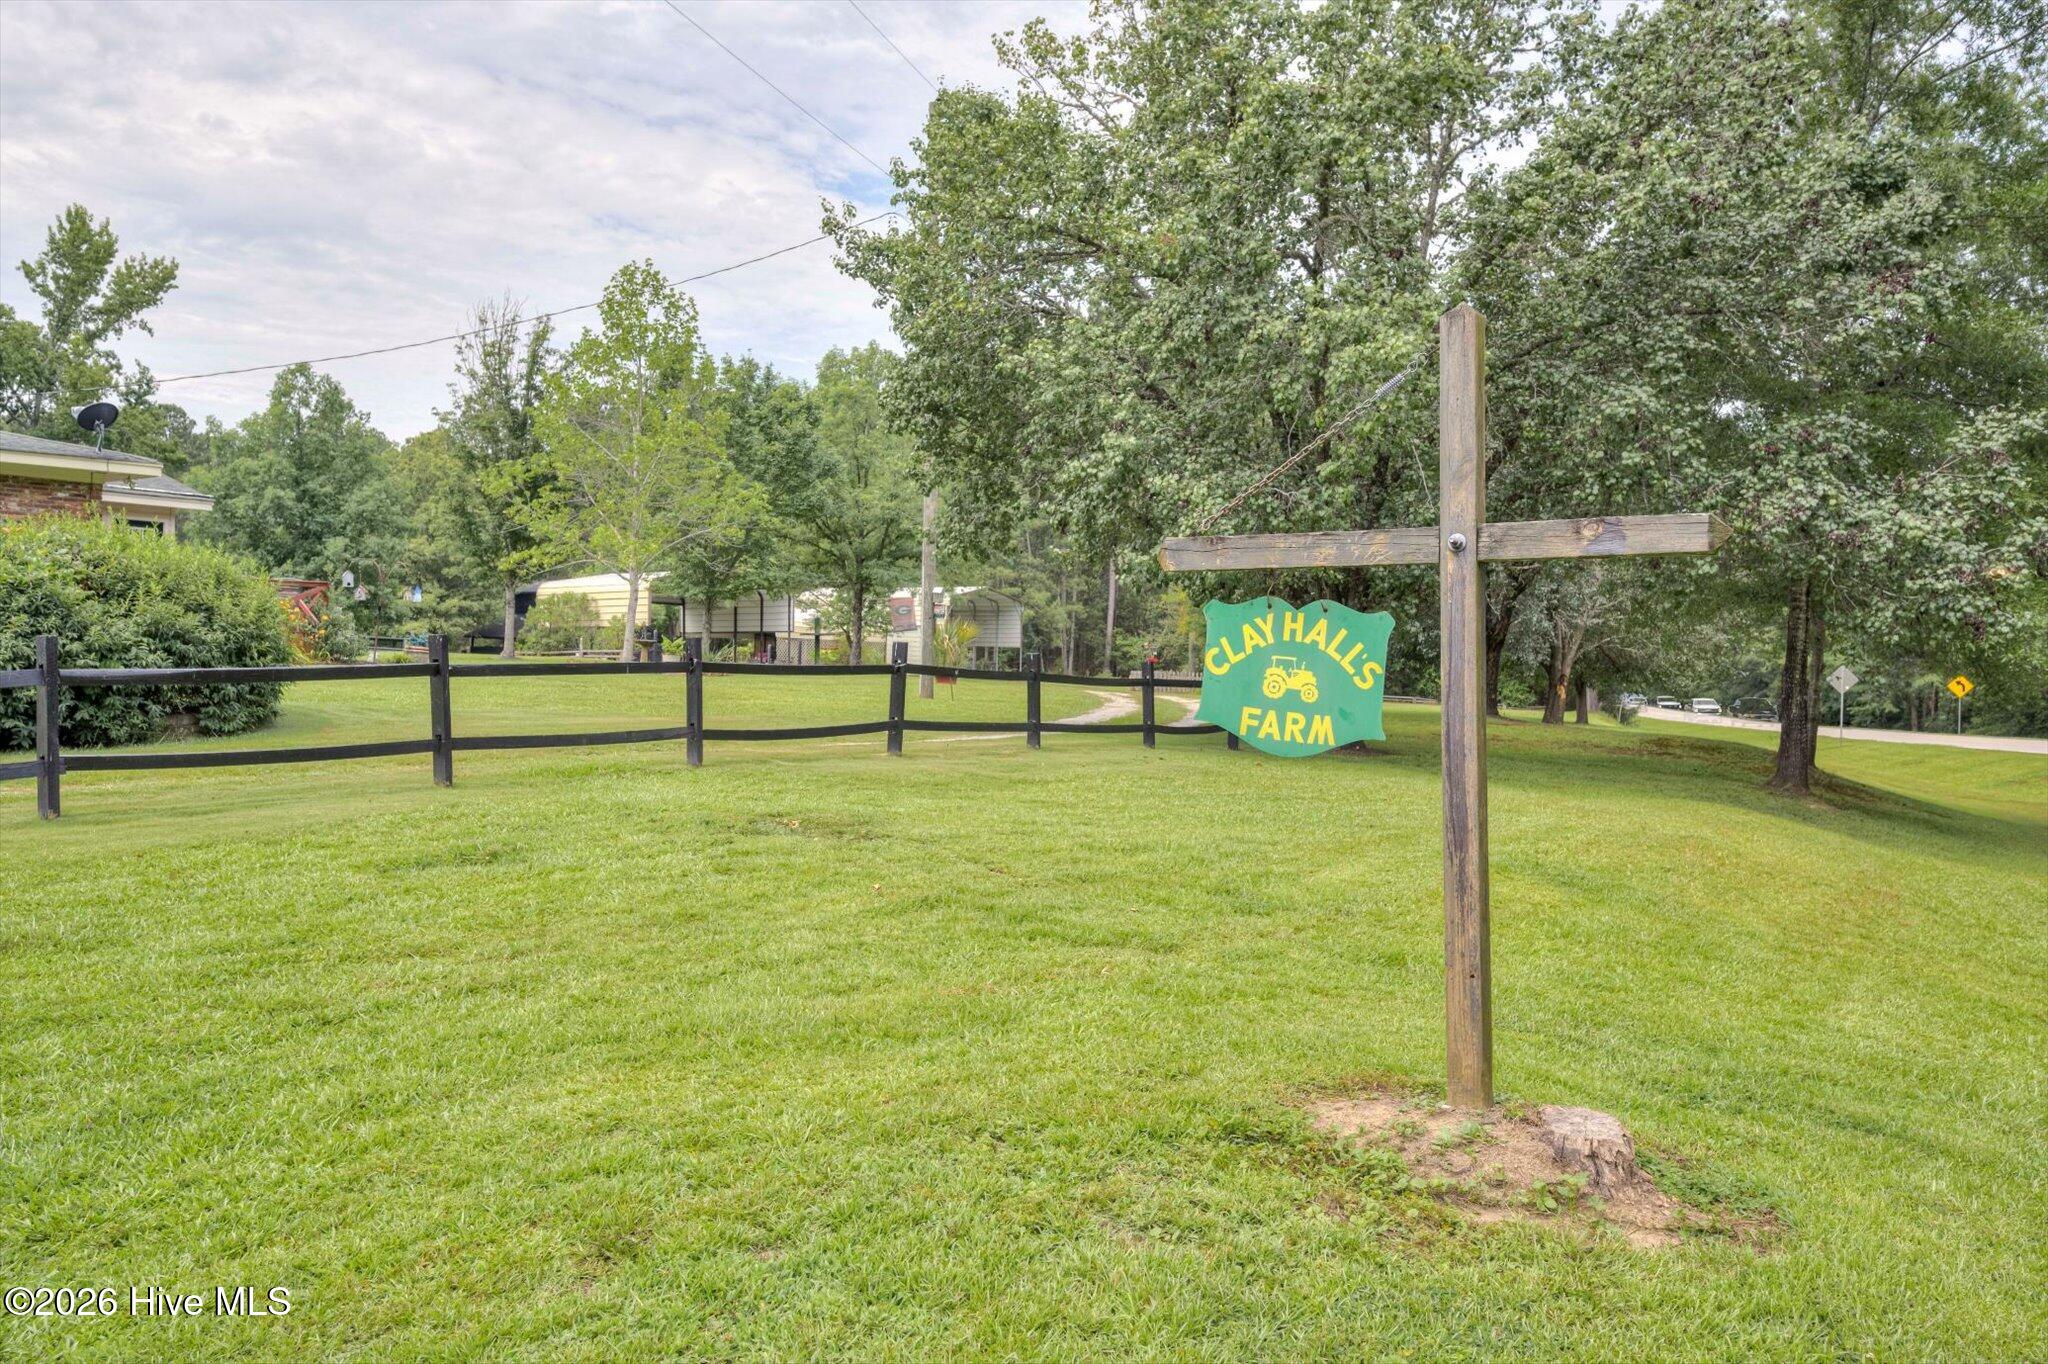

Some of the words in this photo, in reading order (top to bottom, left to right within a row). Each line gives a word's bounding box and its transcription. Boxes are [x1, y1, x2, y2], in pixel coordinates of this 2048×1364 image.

[1205, 613, 1274, 675] CLAY
[1283, 611, 1383, 690] HALL'S
[1239, 706, 1336, 746] FARM
